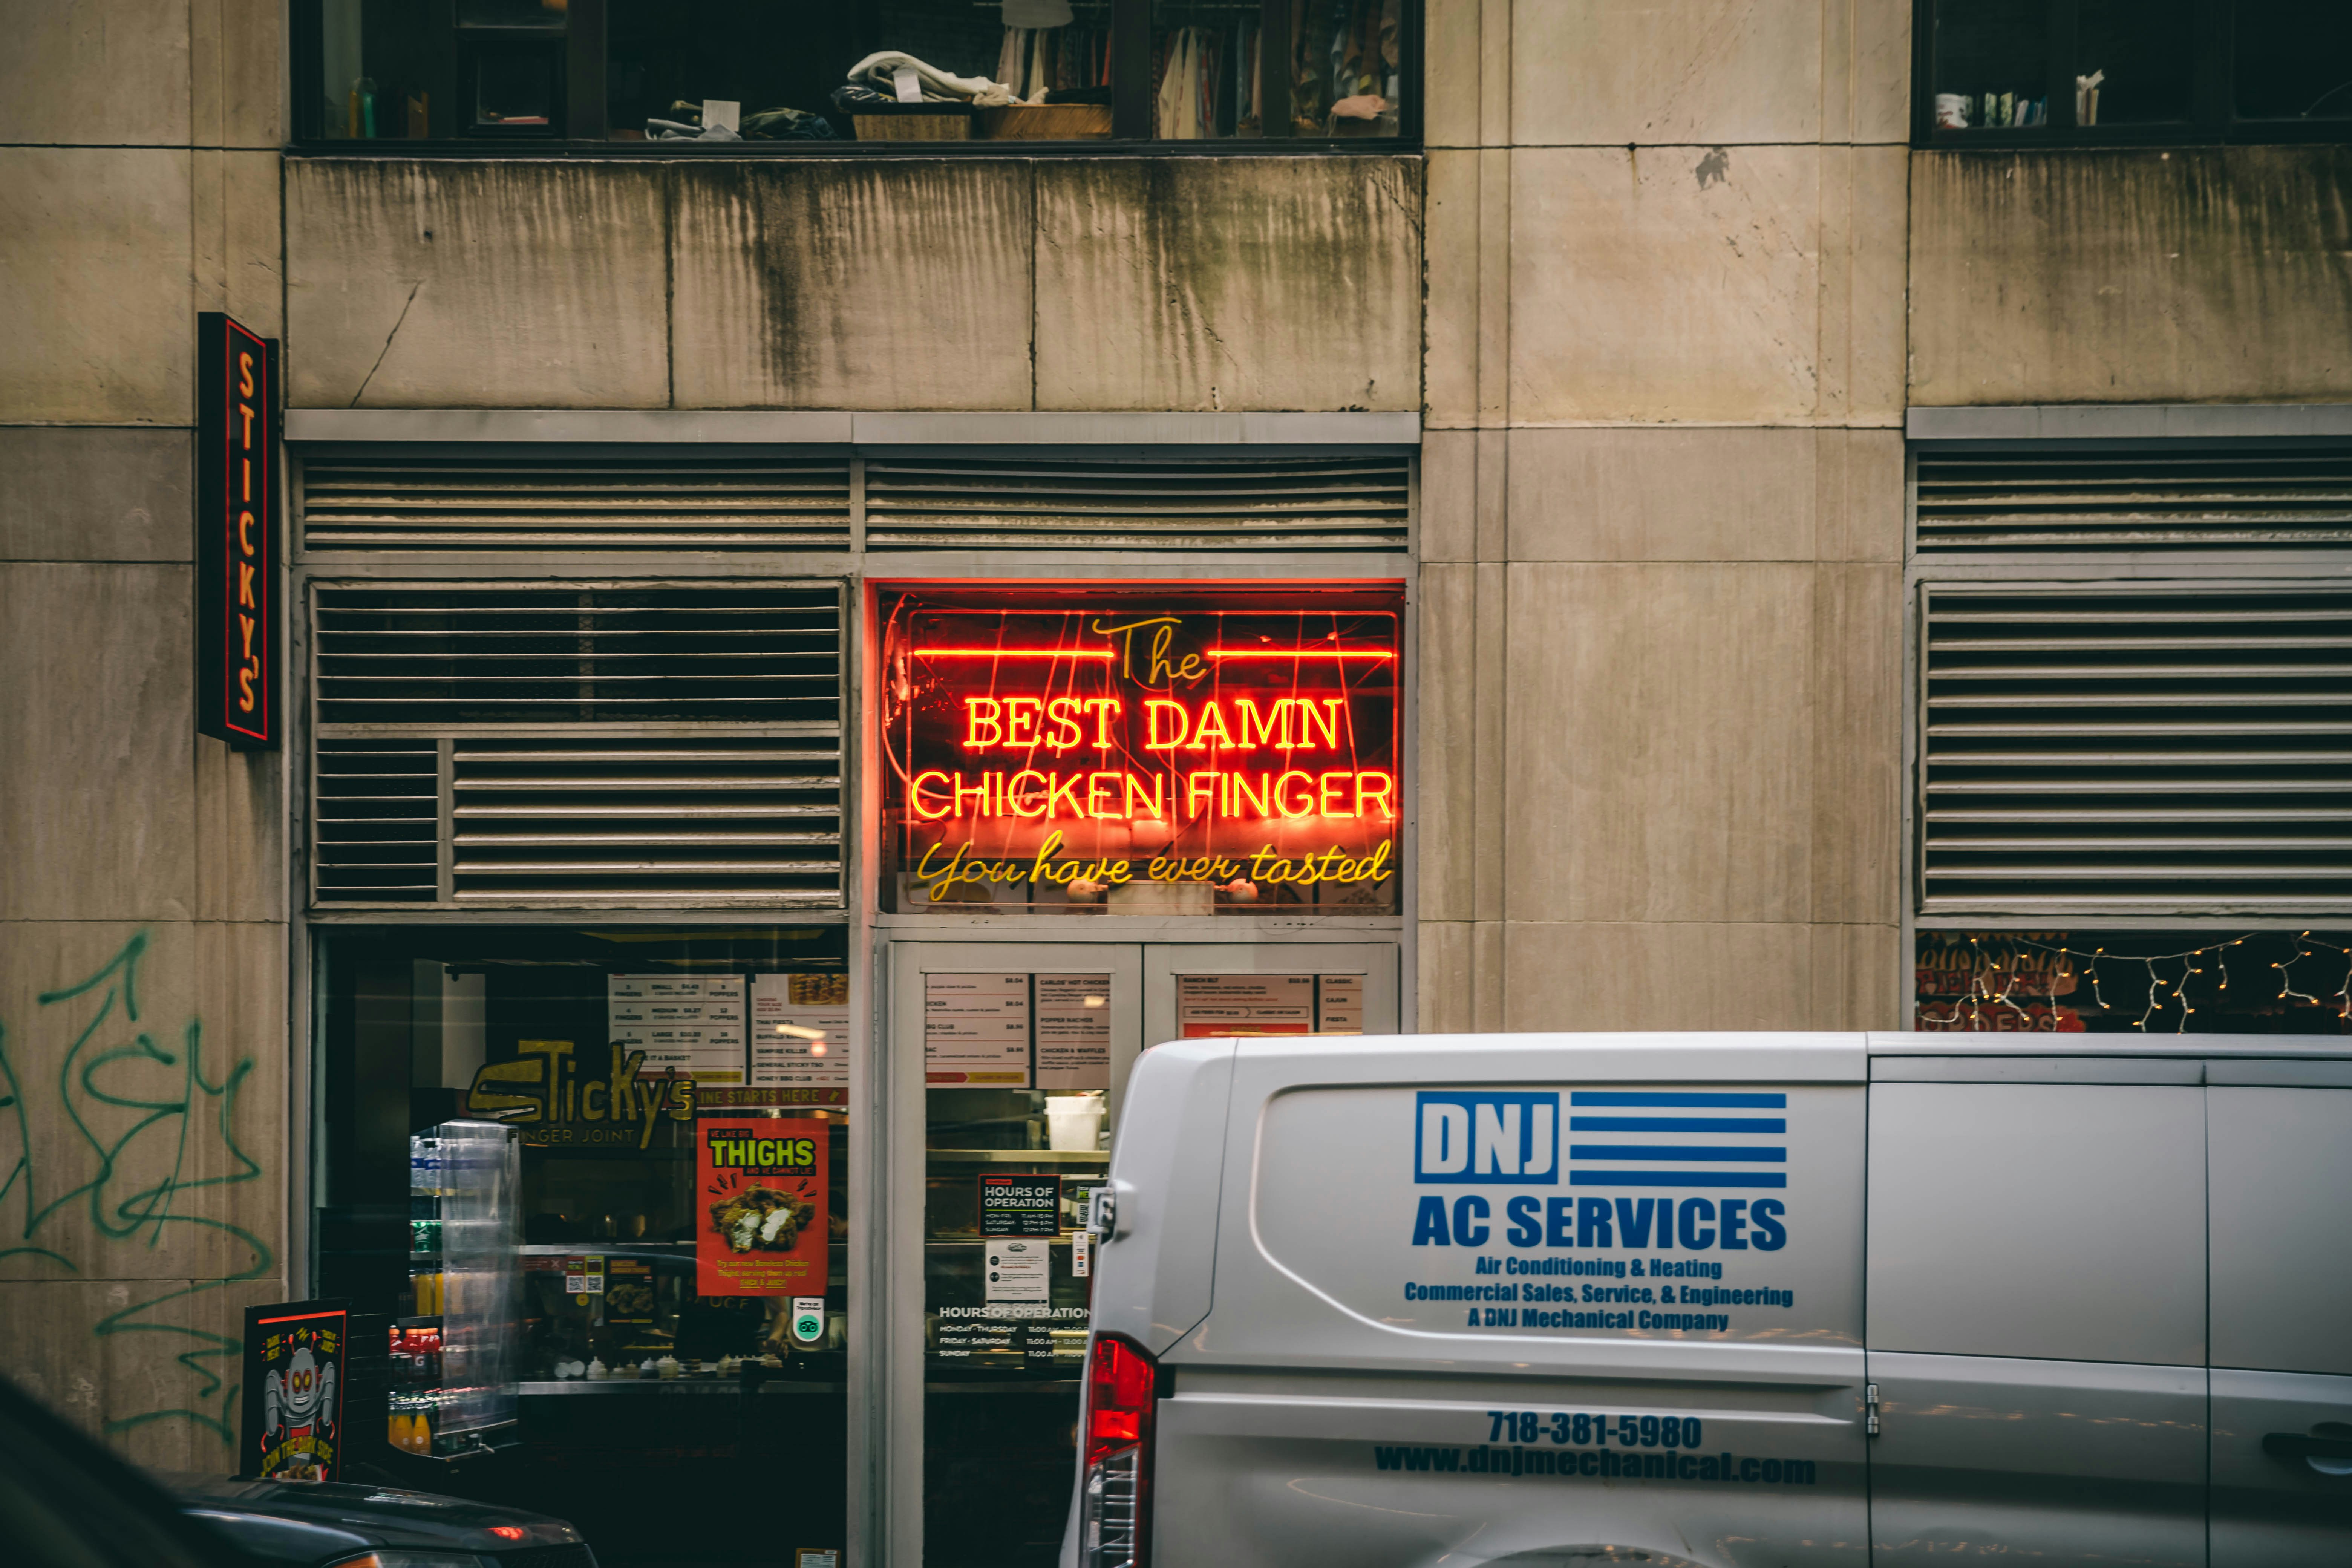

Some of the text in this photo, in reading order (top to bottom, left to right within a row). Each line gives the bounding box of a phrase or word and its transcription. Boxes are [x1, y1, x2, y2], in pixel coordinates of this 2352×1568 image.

[239, 351, 259, 713] STICKY'S
[1092, 617, 1208, 684] The
[963, 698, 1343, 749] BEST DAMN
[911, 771, 1393, 818] CHICKEN FINGER
[917, 830, 1392, 901] You have ever tasted
[697, 1089, 820, 1104] INE STARTS HERE
[582, 1129, 635, 1143] JOINT
[710, 1140, 814, 1166] THIGHS
[1421, 1103, 1553, 1175] DNJ
[985, 1187, 1054, 1197] HOURS OF
[985, 1198, 1054, 1207] OPERATION
[1412, 1195, 1787, 1251] AC SERVICES
[1475, 1257, 1722, 1280] Air Conditioning & Heating
[939, 1307, 988, 1317] HOURS
[991, 1307, 1011, 1318] OF
[1404, 1283, 1793, 1308] Commercial Sales, Service, & Engineering
[1468, 1309, 1729, 1332] A DNJ Mechanical Company
[1487, 1411, 1702, 1449] 718-381-5980
[261, 1447, 280, 1477] JOIN
[281, 1438, 298, 1459] THE
[317, 1440, 334, 1464] SIDE
[1375, 1444, 1816, 1484] www.dnjmechanical.com
